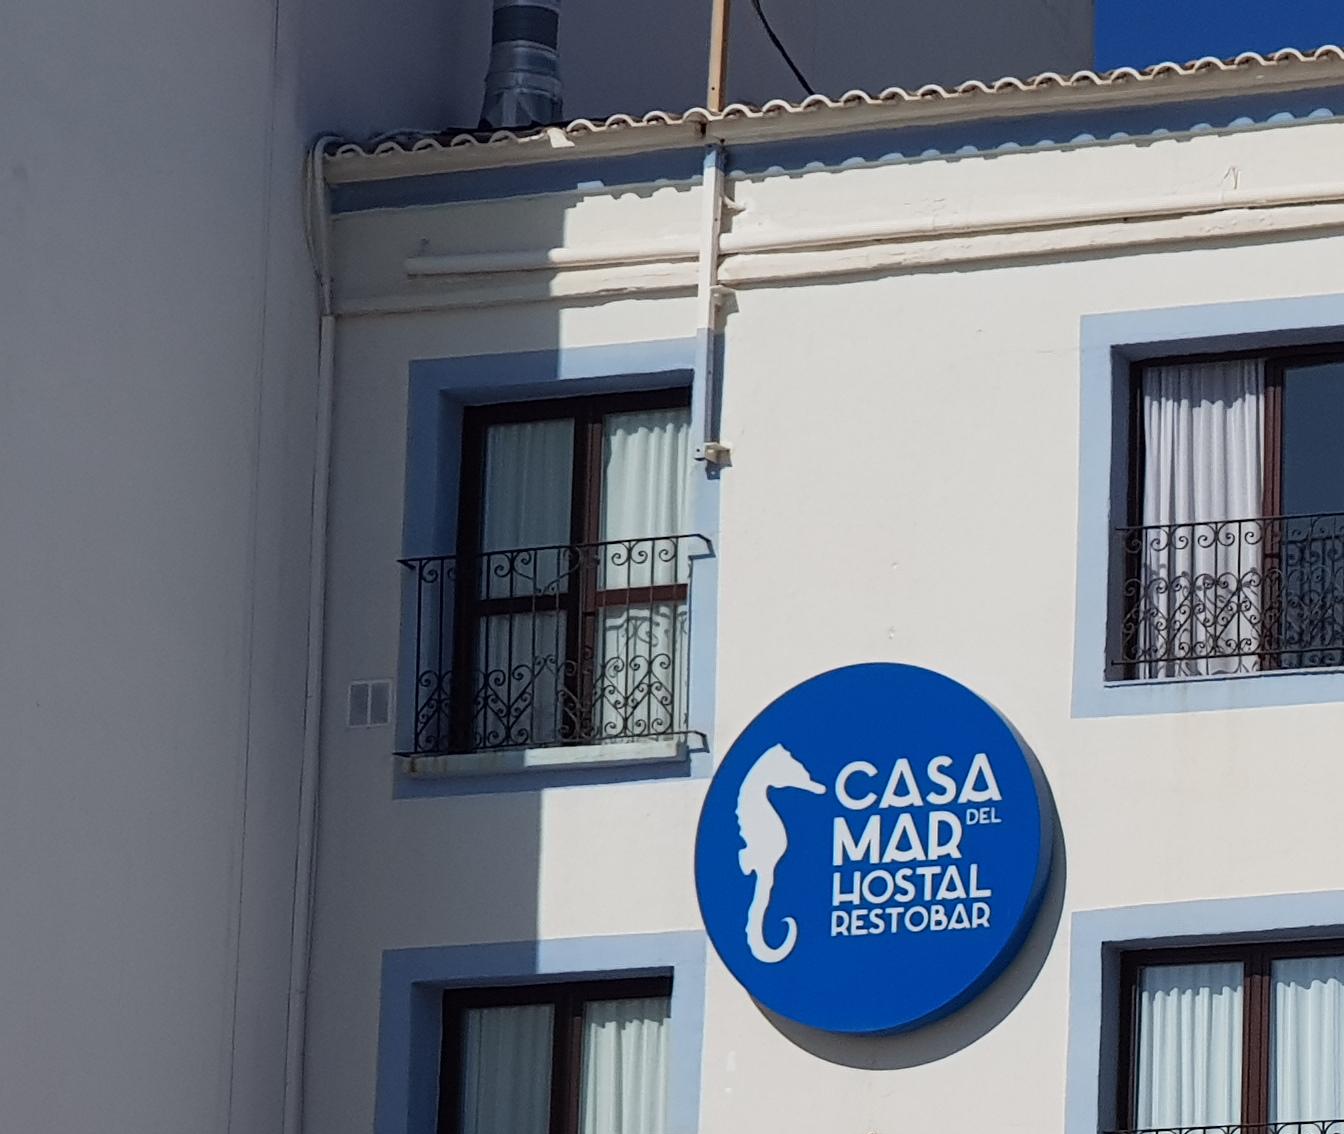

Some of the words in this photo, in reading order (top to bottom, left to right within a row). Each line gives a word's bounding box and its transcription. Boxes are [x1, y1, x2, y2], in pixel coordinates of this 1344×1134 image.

[834, 753, 1002, 810] CASA
[832, 809, 963, 866] MAR
[966, 807, 1002, 826] DEL
[831, 864, 992, 906] HOSTAL
[830, 904, 991, 936] RESTOBAR
